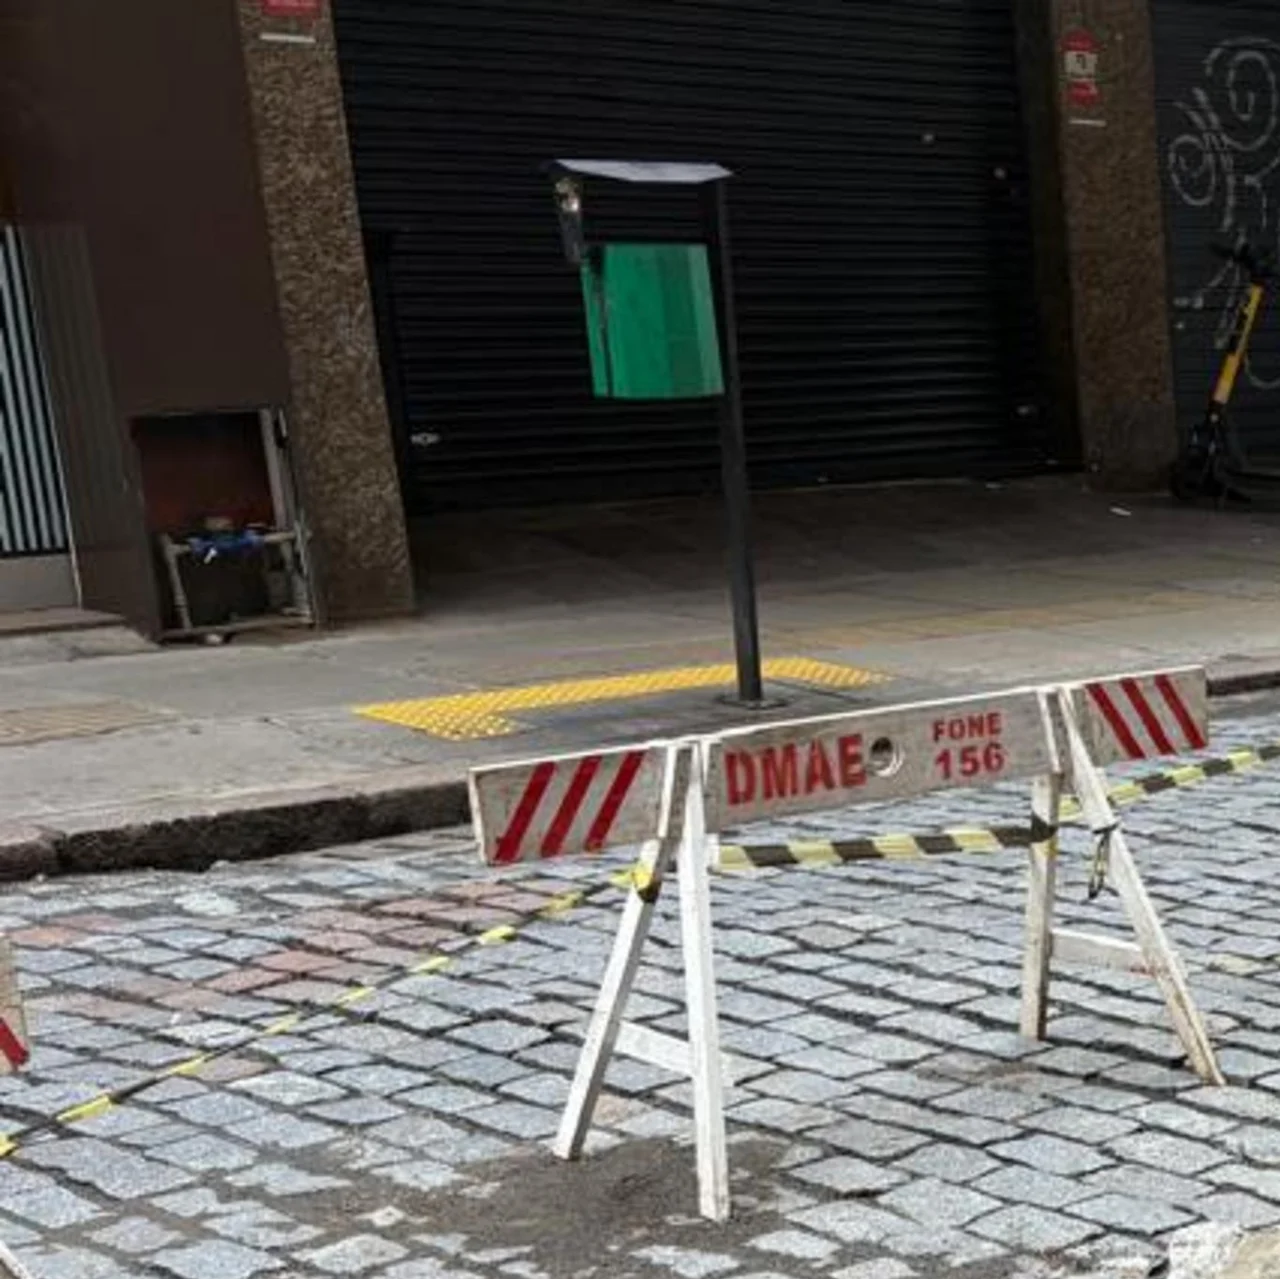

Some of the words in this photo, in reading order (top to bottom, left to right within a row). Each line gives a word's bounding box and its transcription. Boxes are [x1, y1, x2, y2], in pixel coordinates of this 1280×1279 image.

[931, 711, 1003, 743] FONE
[723, 732, 867, 806] DMAE
[935, 742, 1005, 779] 156
